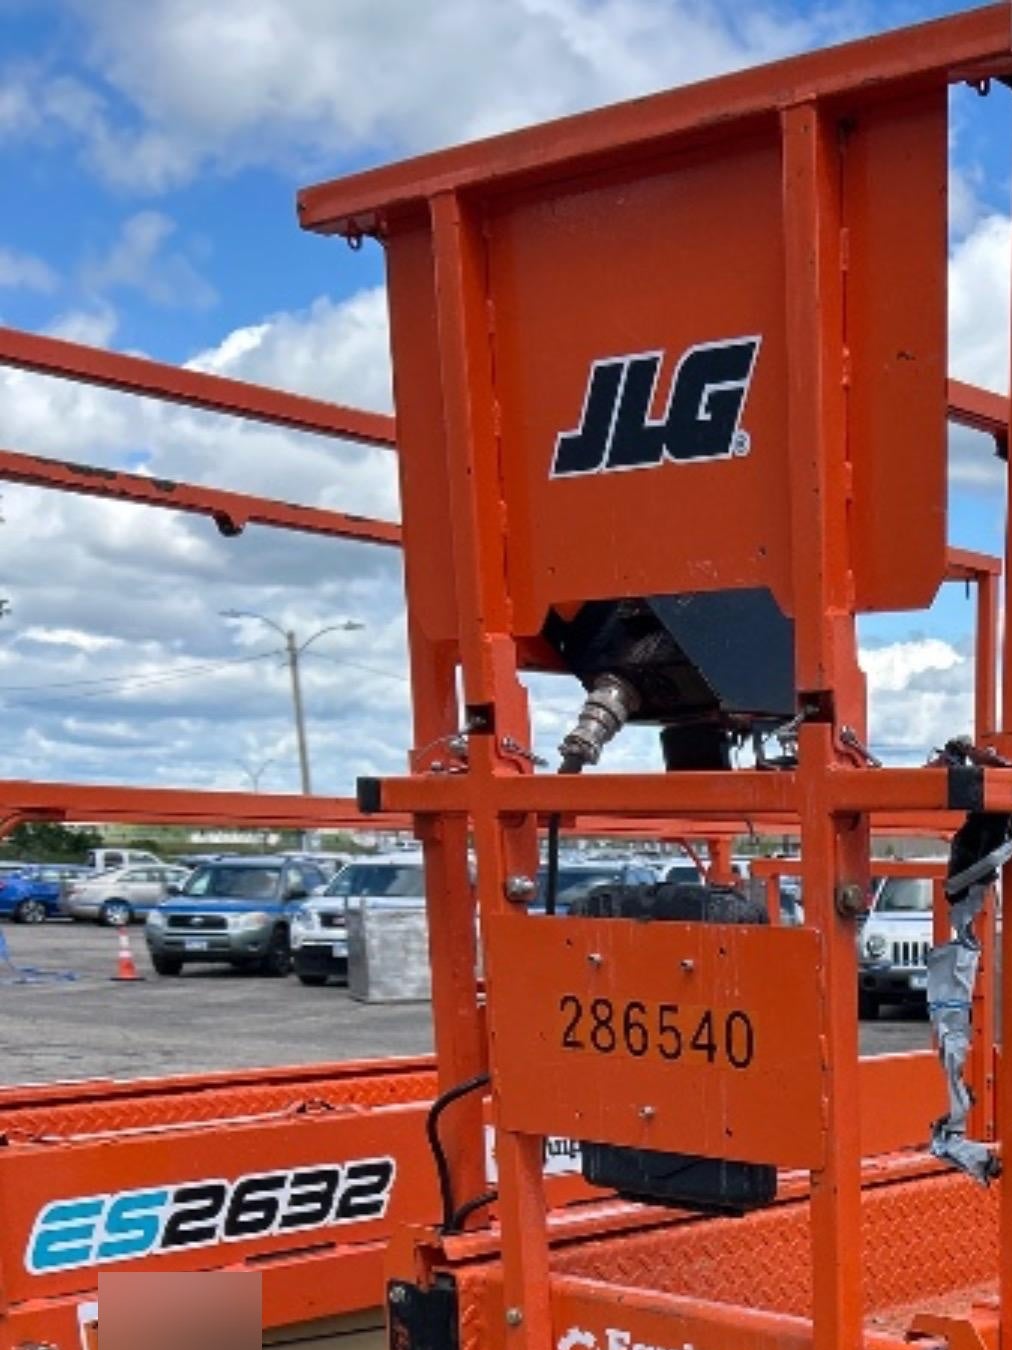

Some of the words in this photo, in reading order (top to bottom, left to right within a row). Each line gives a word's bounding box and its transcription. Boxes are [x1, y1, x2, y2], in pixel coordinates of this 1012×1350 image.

[549, 334, 763, 480] JLG
[560, 996, 754, 1068] 286540
[27, 1157, 396, 1272] ES2632
